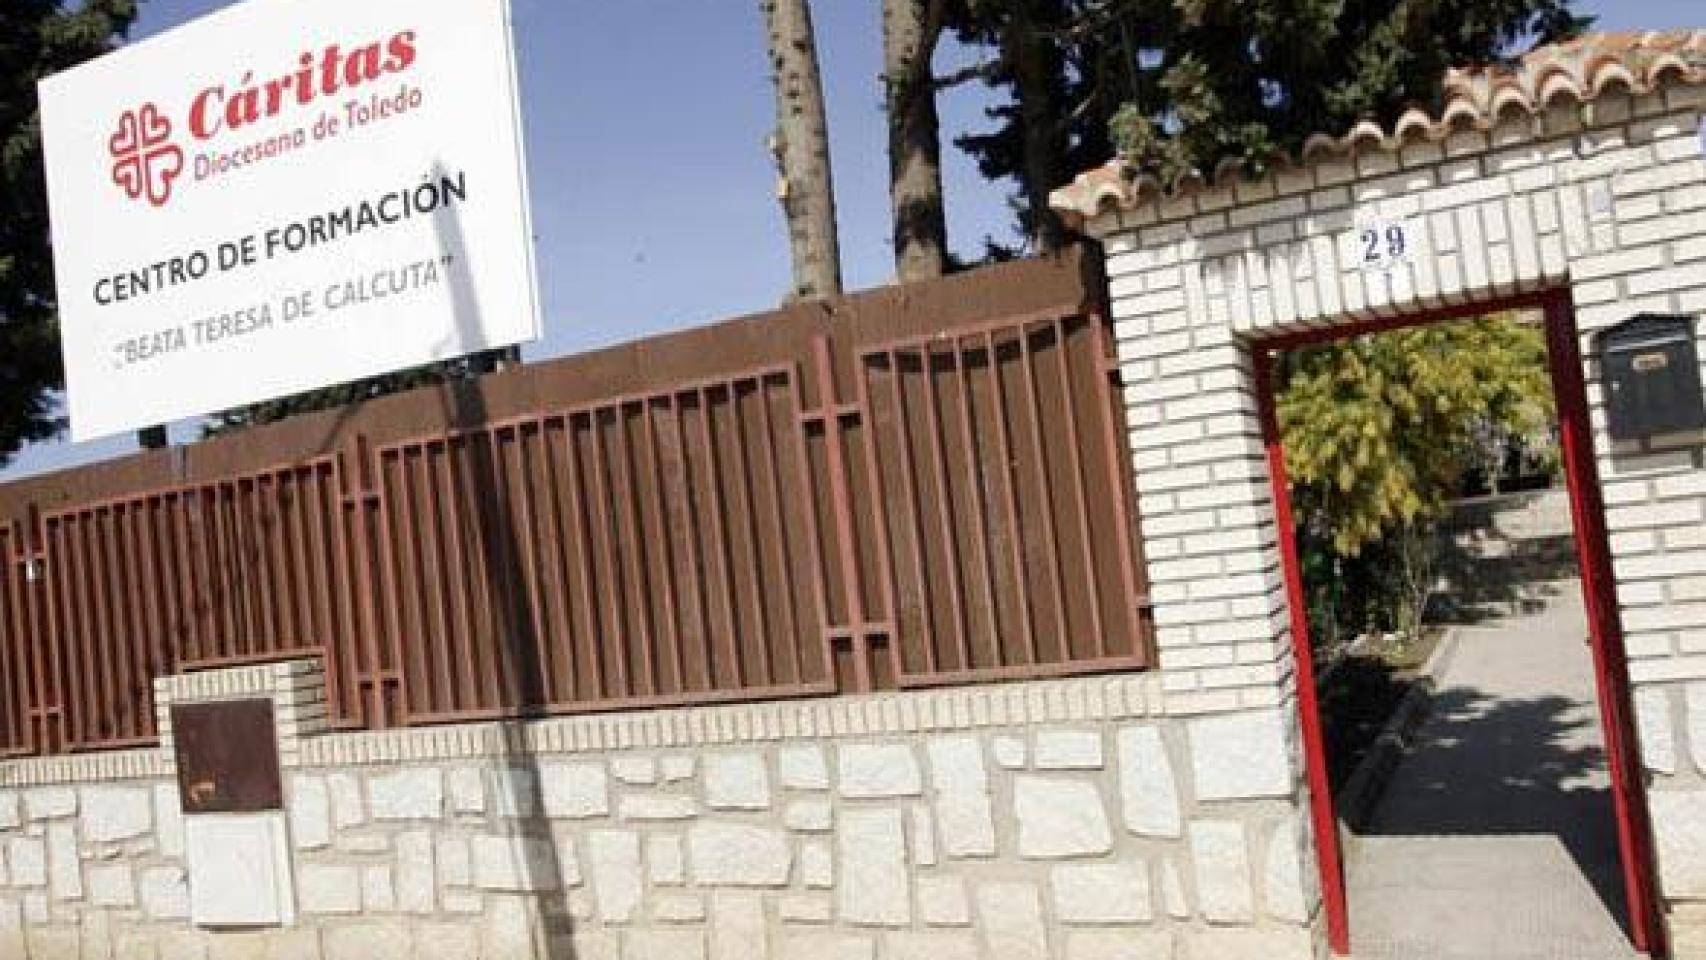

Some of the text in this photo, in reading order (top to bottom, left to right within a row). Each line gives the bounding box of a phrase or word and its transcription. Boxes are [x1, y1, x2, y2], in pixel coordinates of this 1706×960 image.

[188, 28, 417, 141] Cáritas
[193, 83, 422, 182] Diocesana de Toledo
[93, 170, 467, 306] CENTRO DE FORMACIÓN
[1360, 224, 1404, 262] 29
[191, 303, 273, 345] TERESA
[281, 290, 314, 323] DE
